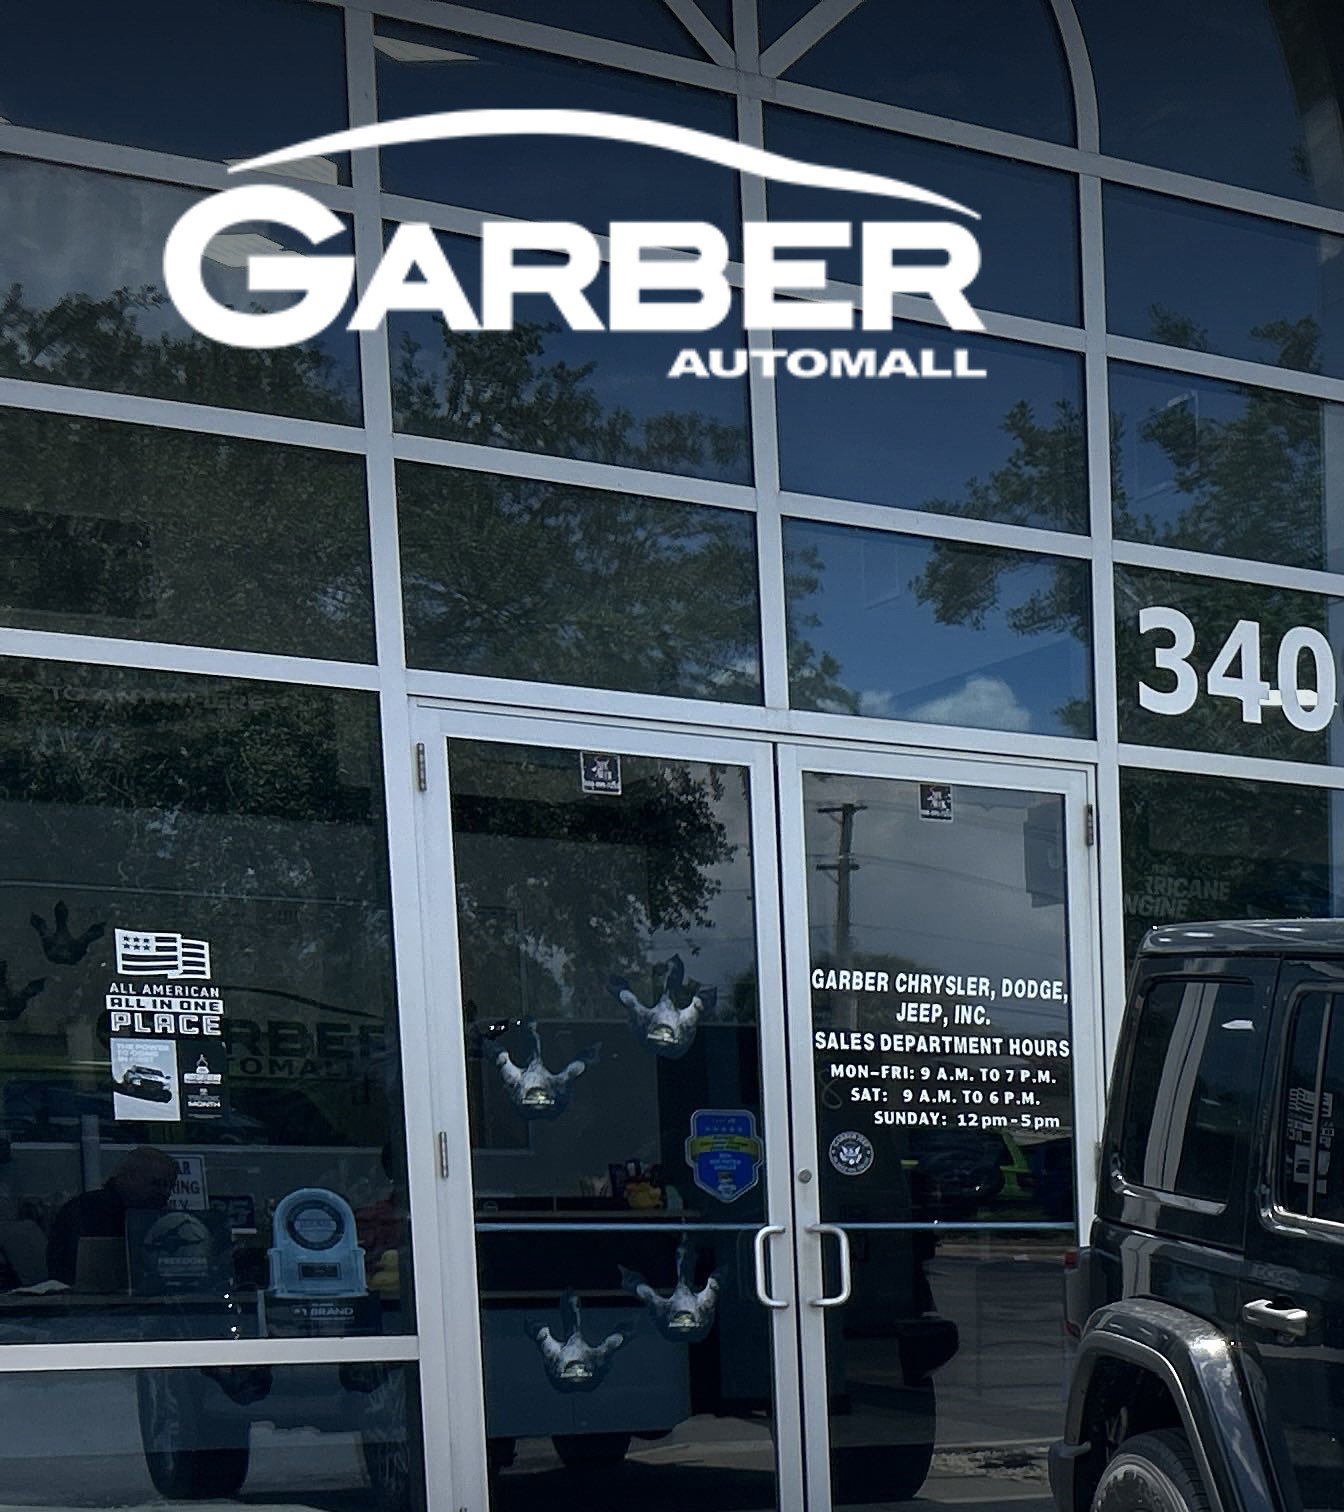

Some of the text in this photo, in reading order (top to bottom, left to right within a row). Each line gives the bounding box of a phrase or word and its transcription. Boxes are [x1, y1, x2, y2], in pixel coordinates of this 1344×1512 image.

[1123, 893, 1188, 919] NGINE
[109, 983, 220, 998] ALL AMERICAN
[811, 968, 1069, 1004] GARBER CHRYSLER, DODGE,
[111, 998, 220, 1012] ALL IN ONE
[896, 1002, 991, 1028] JEEP, INC.
[111, 1012, 222, 1036] PLACE
[815, 1032, 1070, 1058] SALES DEPARTMENT HOURS
[920, 1068, 931, 1081] 9
[936, 1067, 975, 1082] A.M.
[980, 1068, 1000, 1083] TO
[1006, 1069, 1014, 1082] 7
[1020, 1069, 1056, 1084] P.M.
[850, 1088, 1041, 1106] SAT: 9 A.M. TO 6 P.M.
[874, 1111, 948, 1126] SUNDAY:
